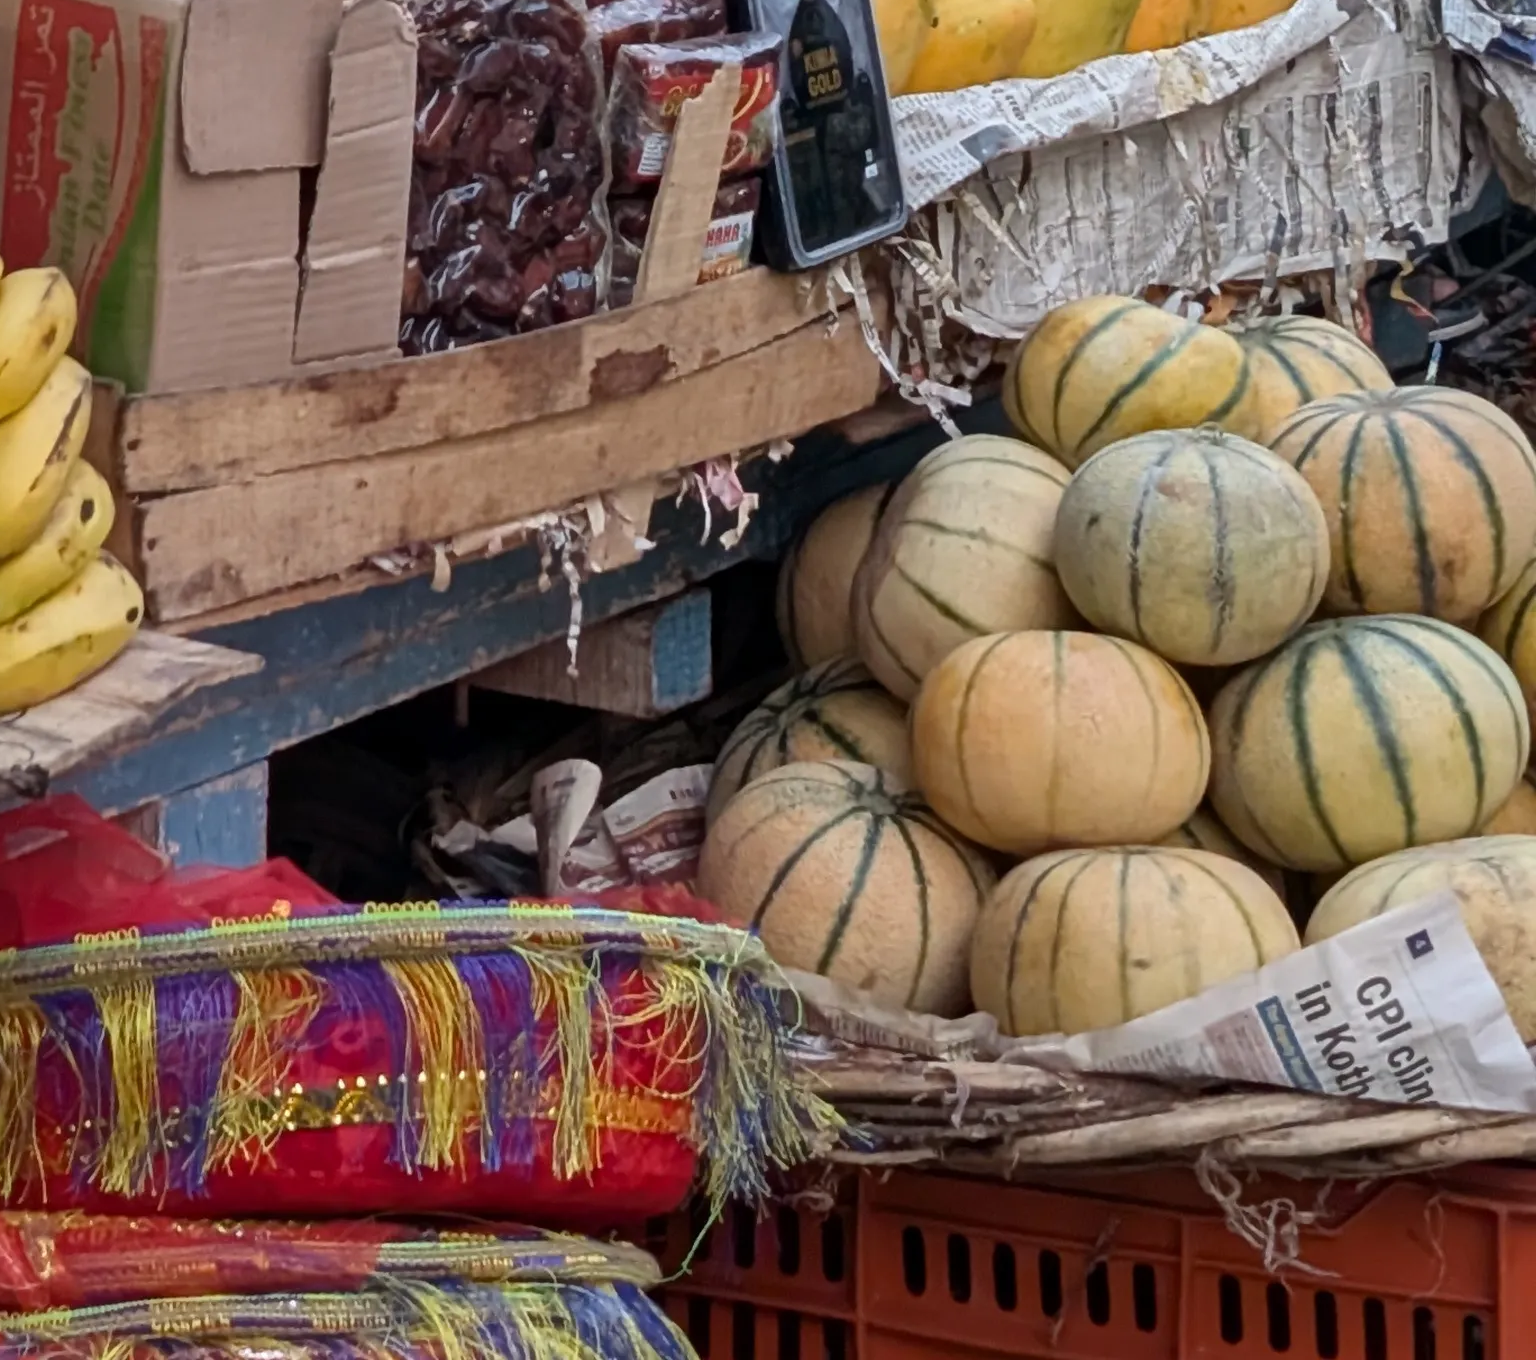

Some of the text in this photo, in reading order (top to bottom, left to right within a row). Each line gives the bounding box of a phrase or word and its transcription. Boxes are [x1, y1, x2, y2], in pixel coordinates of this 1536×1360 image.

[807, 68, 843, 98] GOLD
[1294, 980, 1333, 1022] in
[1355, 976, 1443, 1108] CPI clin
